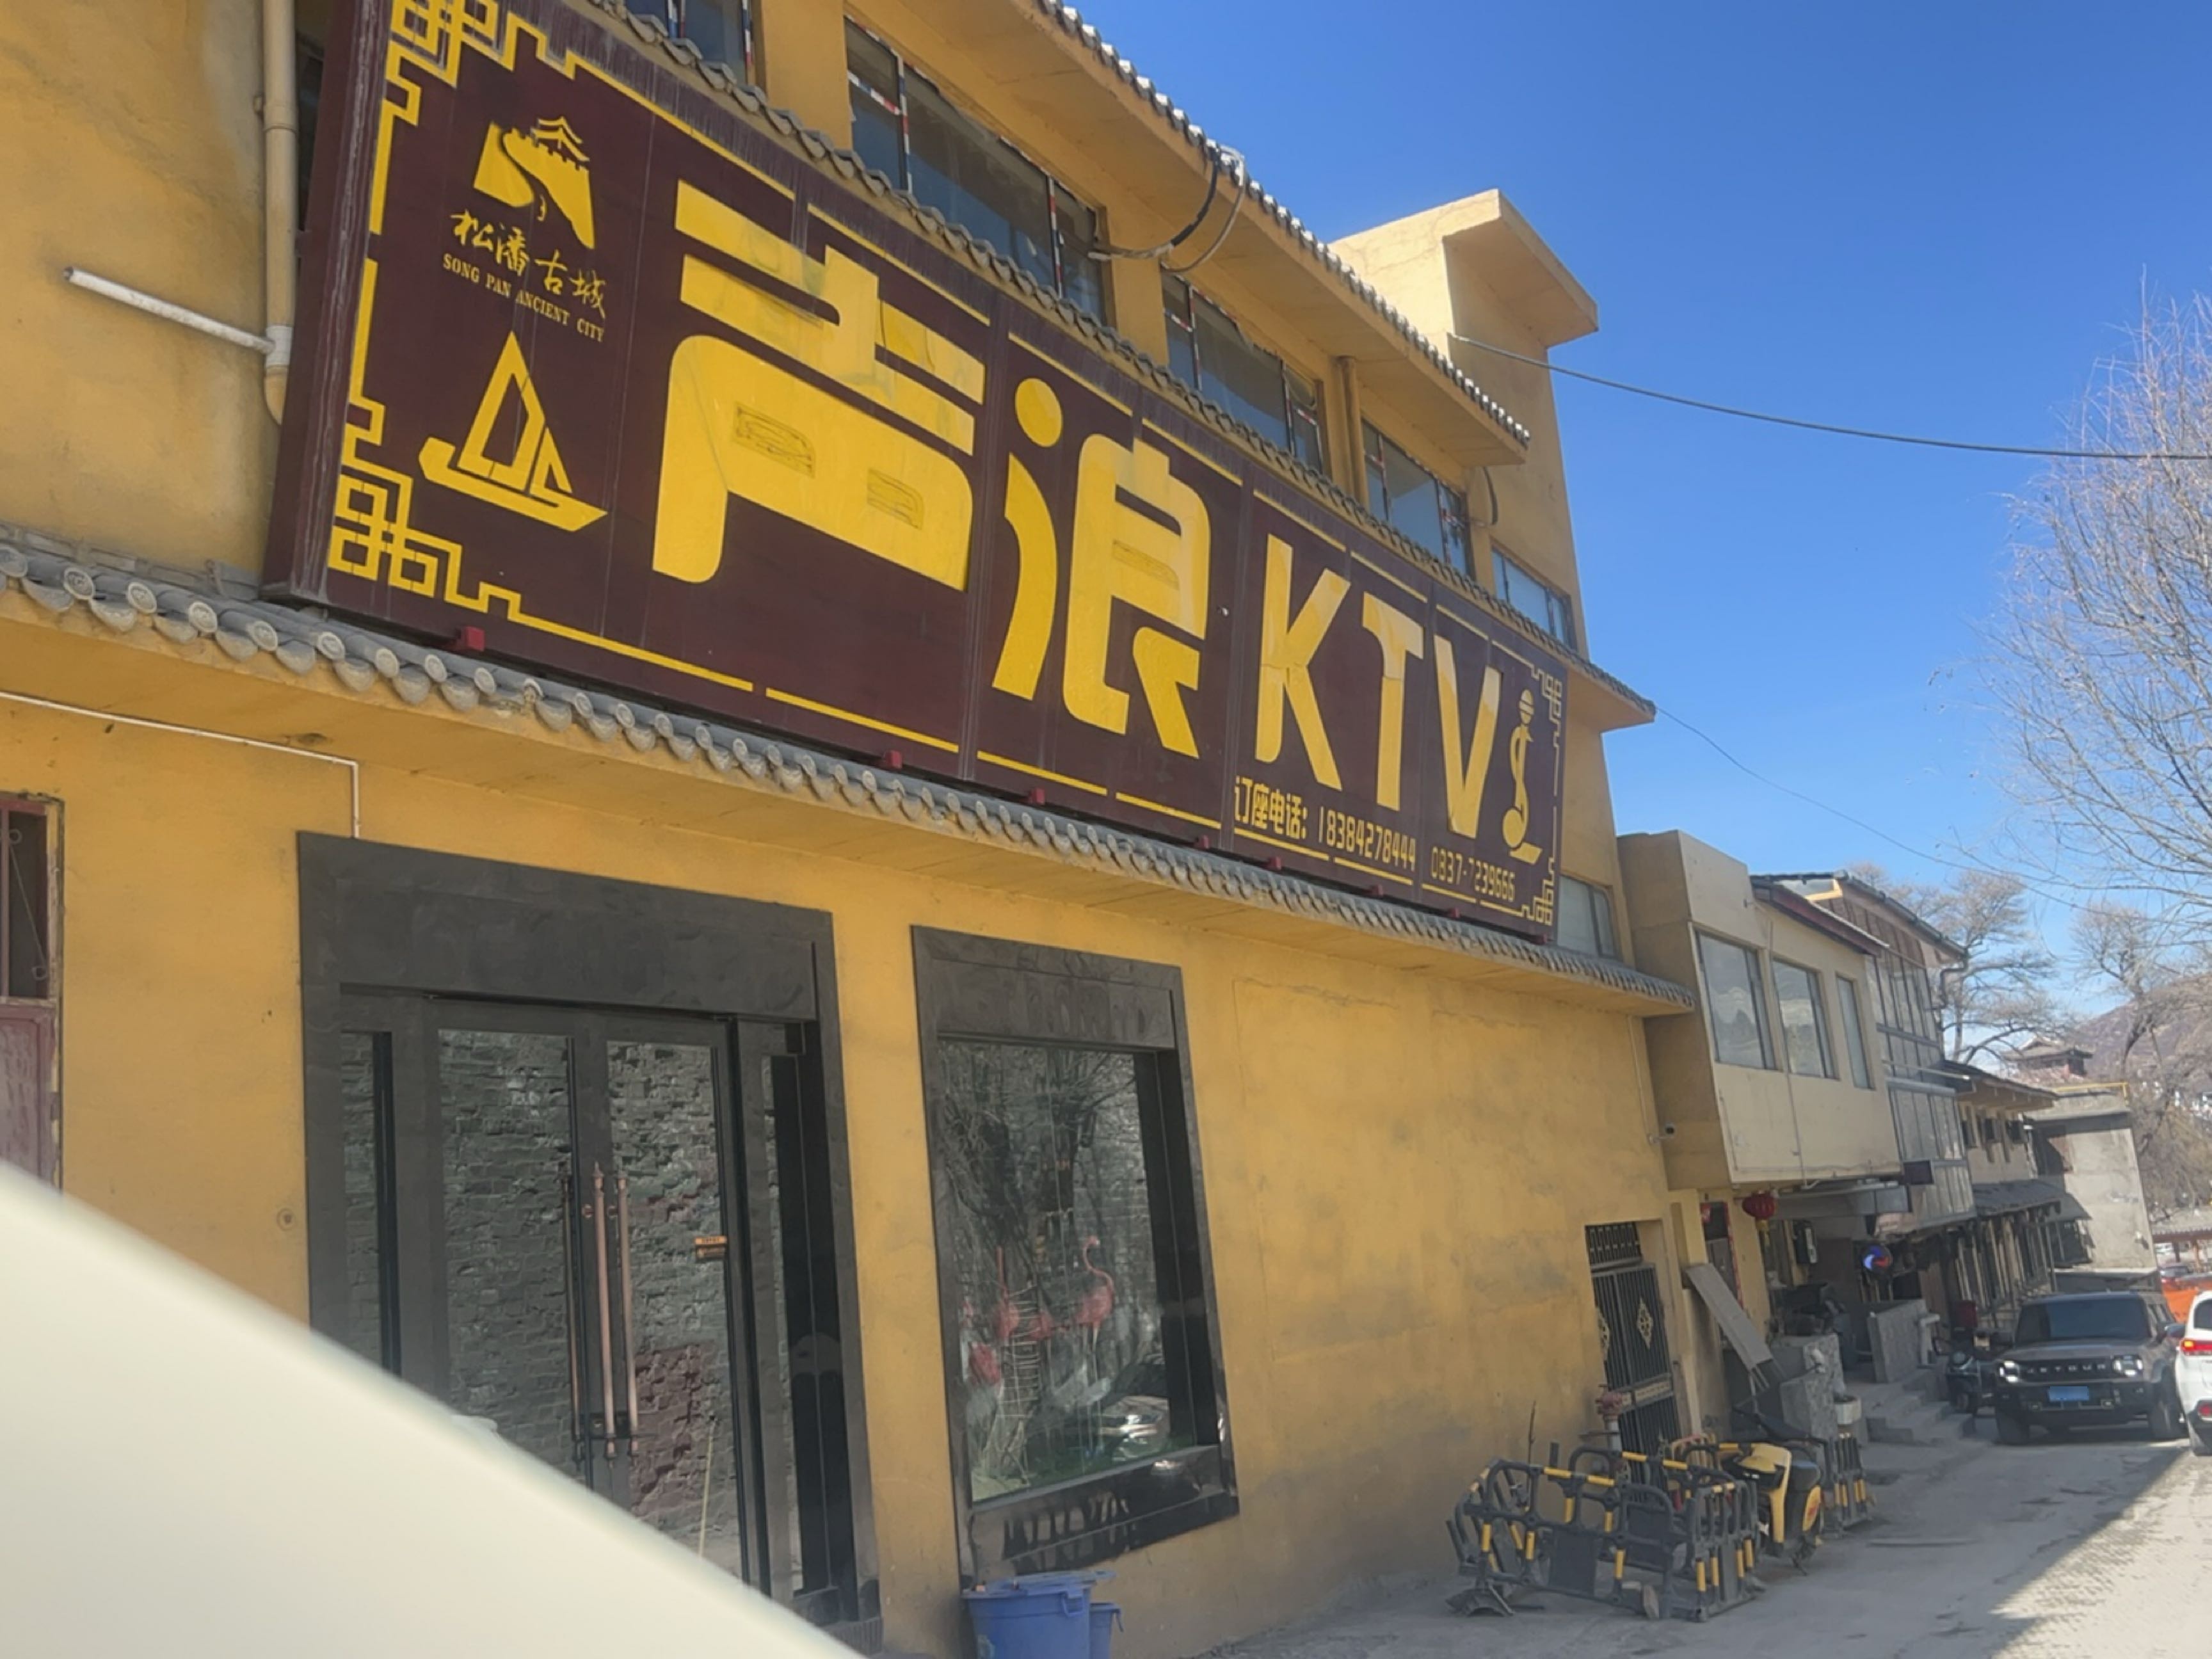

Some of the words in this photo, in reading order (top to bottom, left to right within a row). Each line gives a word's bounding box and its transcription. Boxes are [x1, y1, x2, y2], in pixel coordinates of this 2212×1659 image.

[442, 253, 480, 284] SONG
[485, 273, 512, 298] PAN
[515, 289, 570, 326] ANCIENT
[577, 318, 604, 342] CITY
[450, 209, 605, 319] 松潘古城
[1318, 806, 1416, 872] 18384278444
